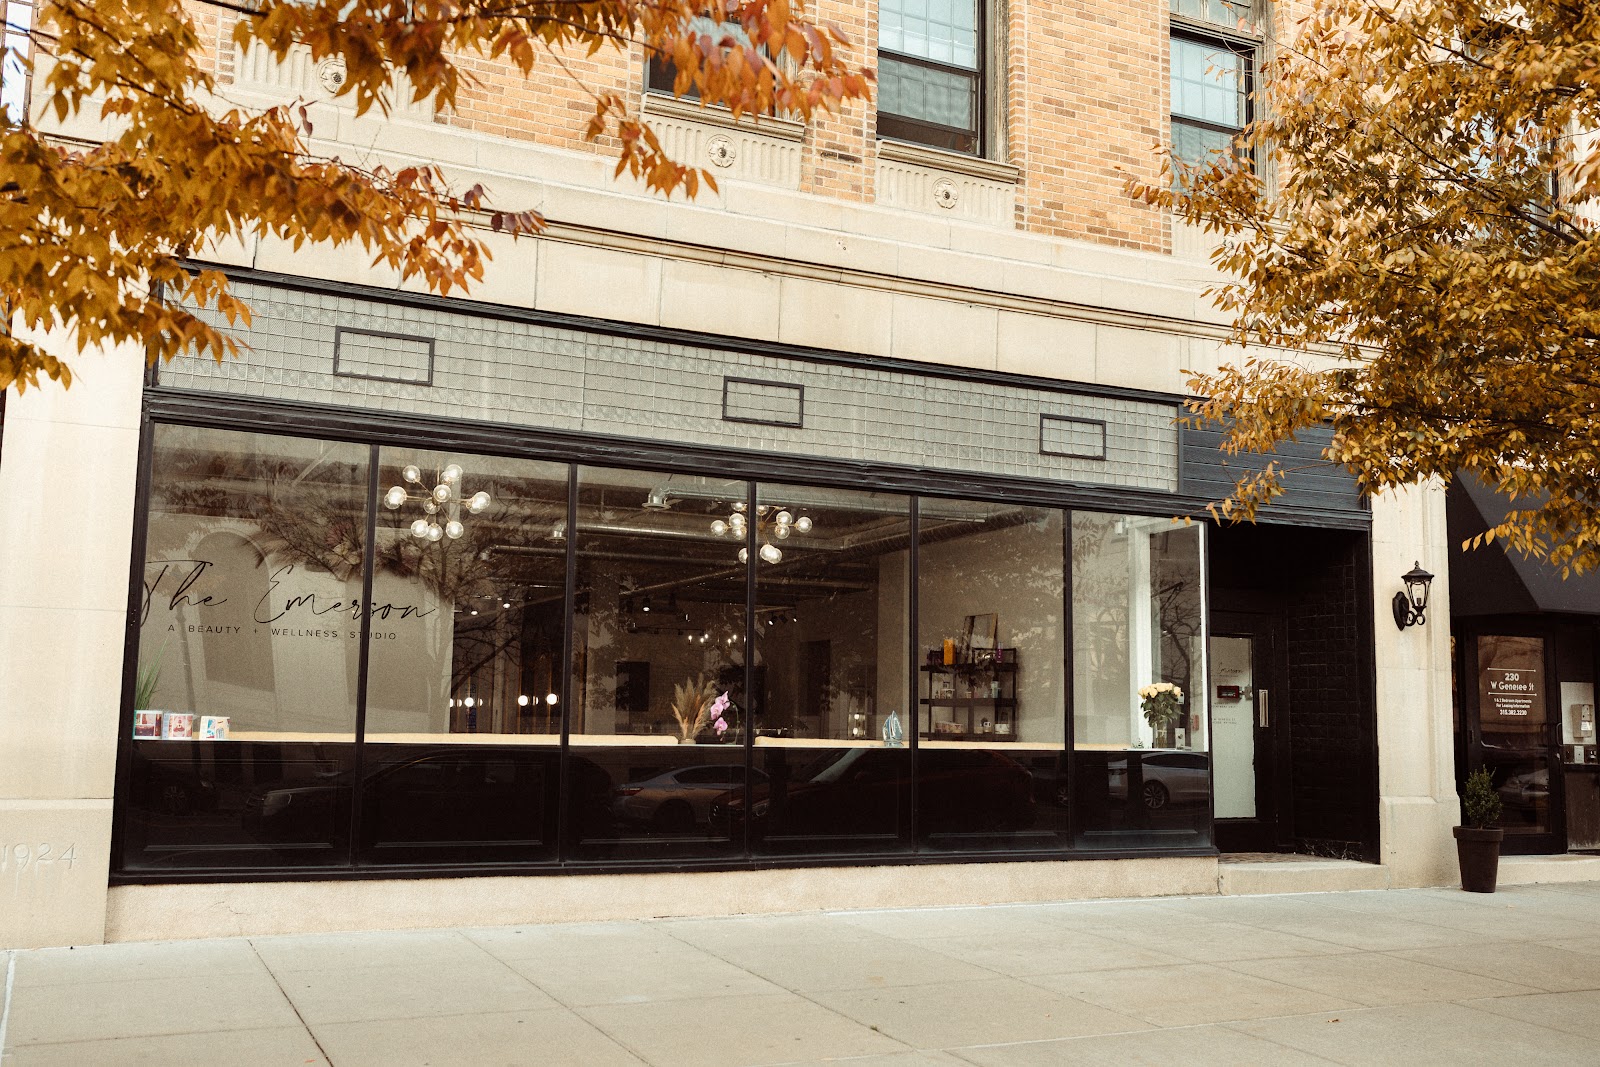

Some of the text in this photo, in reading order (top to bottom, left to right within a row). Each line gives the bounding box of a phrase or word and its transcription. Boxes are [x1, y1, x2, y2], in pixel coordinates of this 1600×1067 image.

[140, 560, 436, 627] The Emerson
[168, 624, 175, 632] A
[189, 625, 241, 634] BEAUTY
[271, 628, 338, 638] WELLNESS
[1504, 673, 1520, 681] 230
[1490, 681, 1534, 691] W Genesee St
[1, 842, 77, 871] 1924
